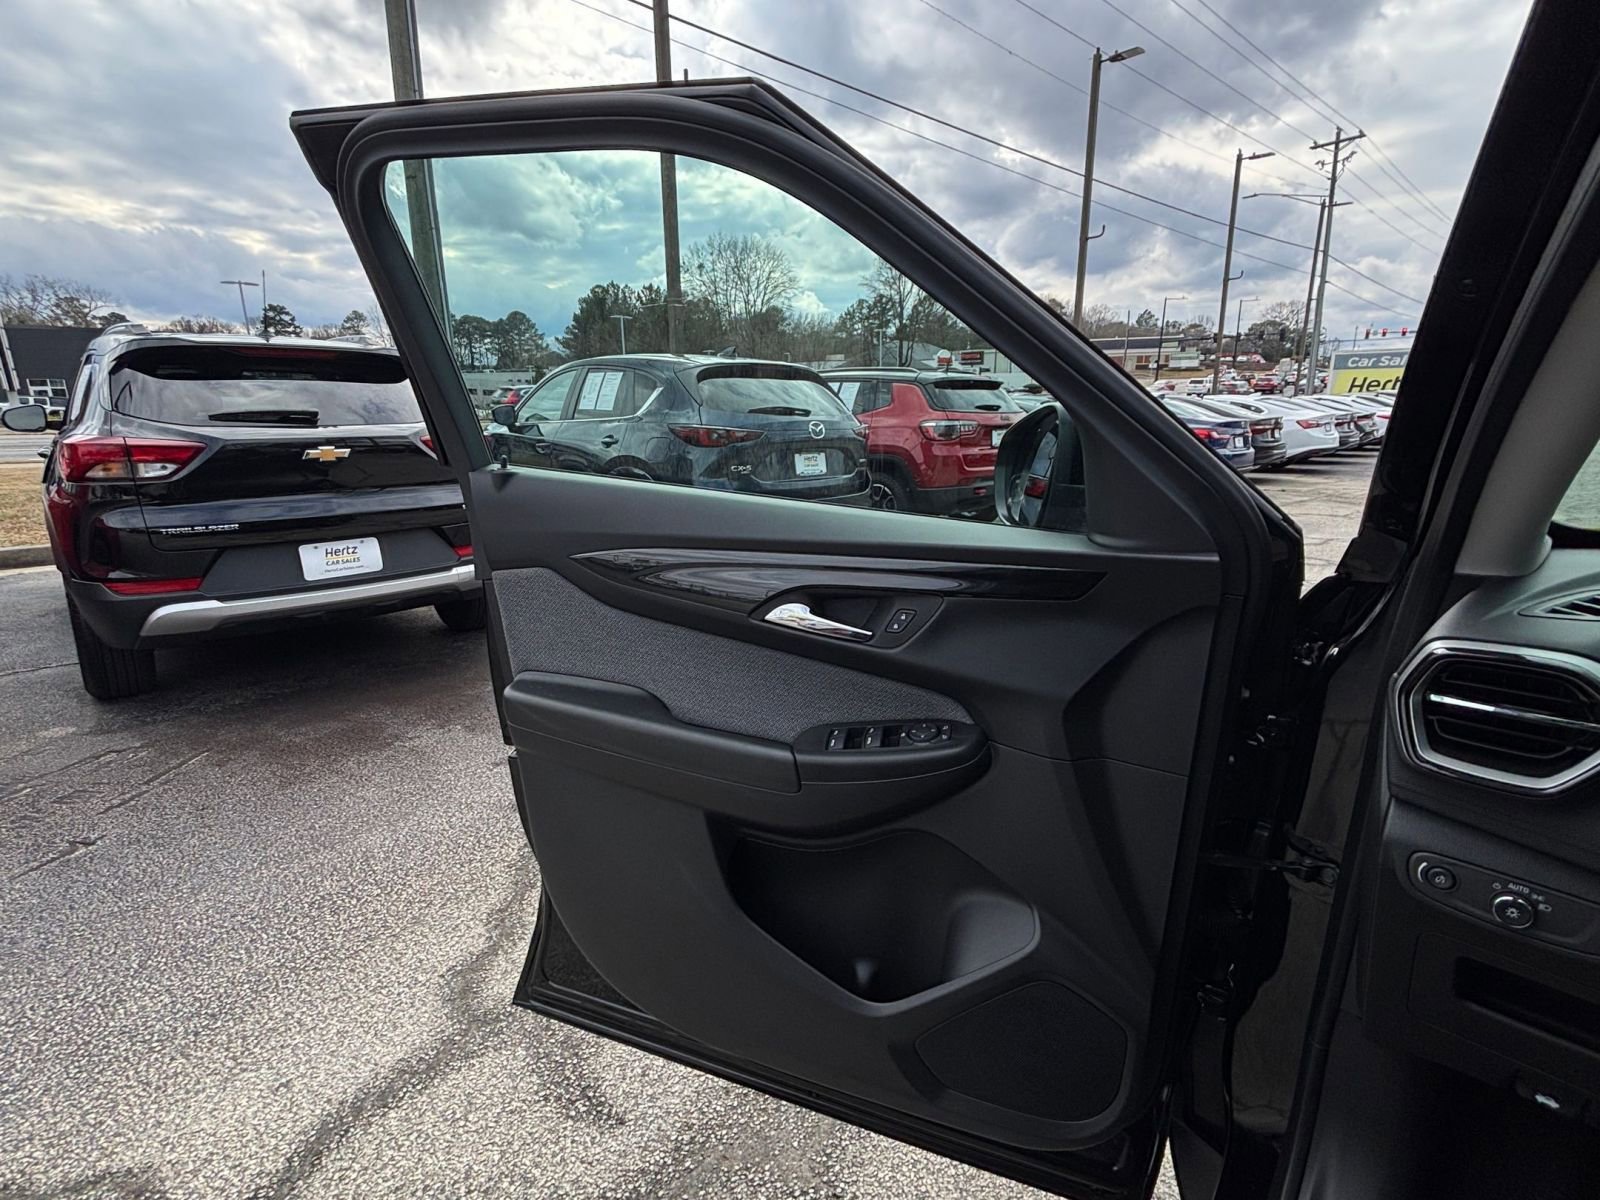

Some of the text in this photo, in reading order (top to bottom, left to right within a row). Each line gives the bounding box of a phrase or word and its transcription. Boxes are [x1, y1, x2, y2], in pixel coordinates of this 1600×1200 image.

[1347, 354, 1408, 368] Car Sal
[1347, 375, 1401, 393] Hert
[324, 545, 359, 558] Hertz
[325, 556, 362, 567] CAR SALES
[1508, 883, 1529, 893] AUTO
